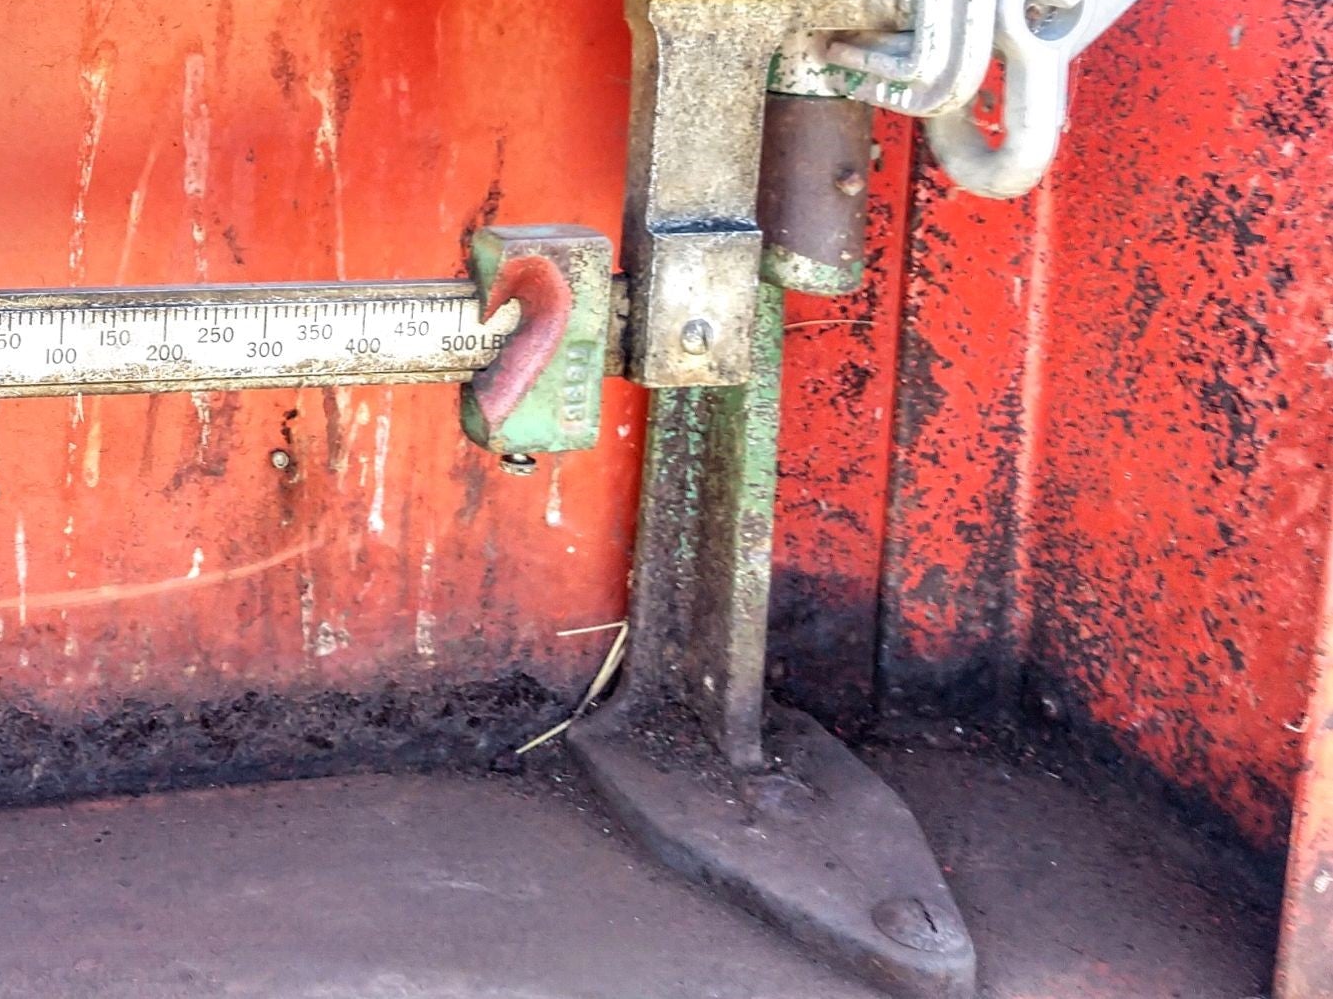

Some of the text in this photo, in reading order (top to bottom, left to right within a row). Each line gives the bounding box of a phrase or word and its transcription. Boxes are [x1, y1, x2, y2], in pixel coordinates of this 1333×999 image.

[100, 330, 131, 346] 150
[197, 327, 234, 343] 250
[297, 324, 333, 340] 350
[394, 321, 429, 337] 450
[45, 349, 77, 364] 100
[146, 344, 184, 361] 200
[247, 341, 283, 358] 300
[345, 337, 381, 354] 400
